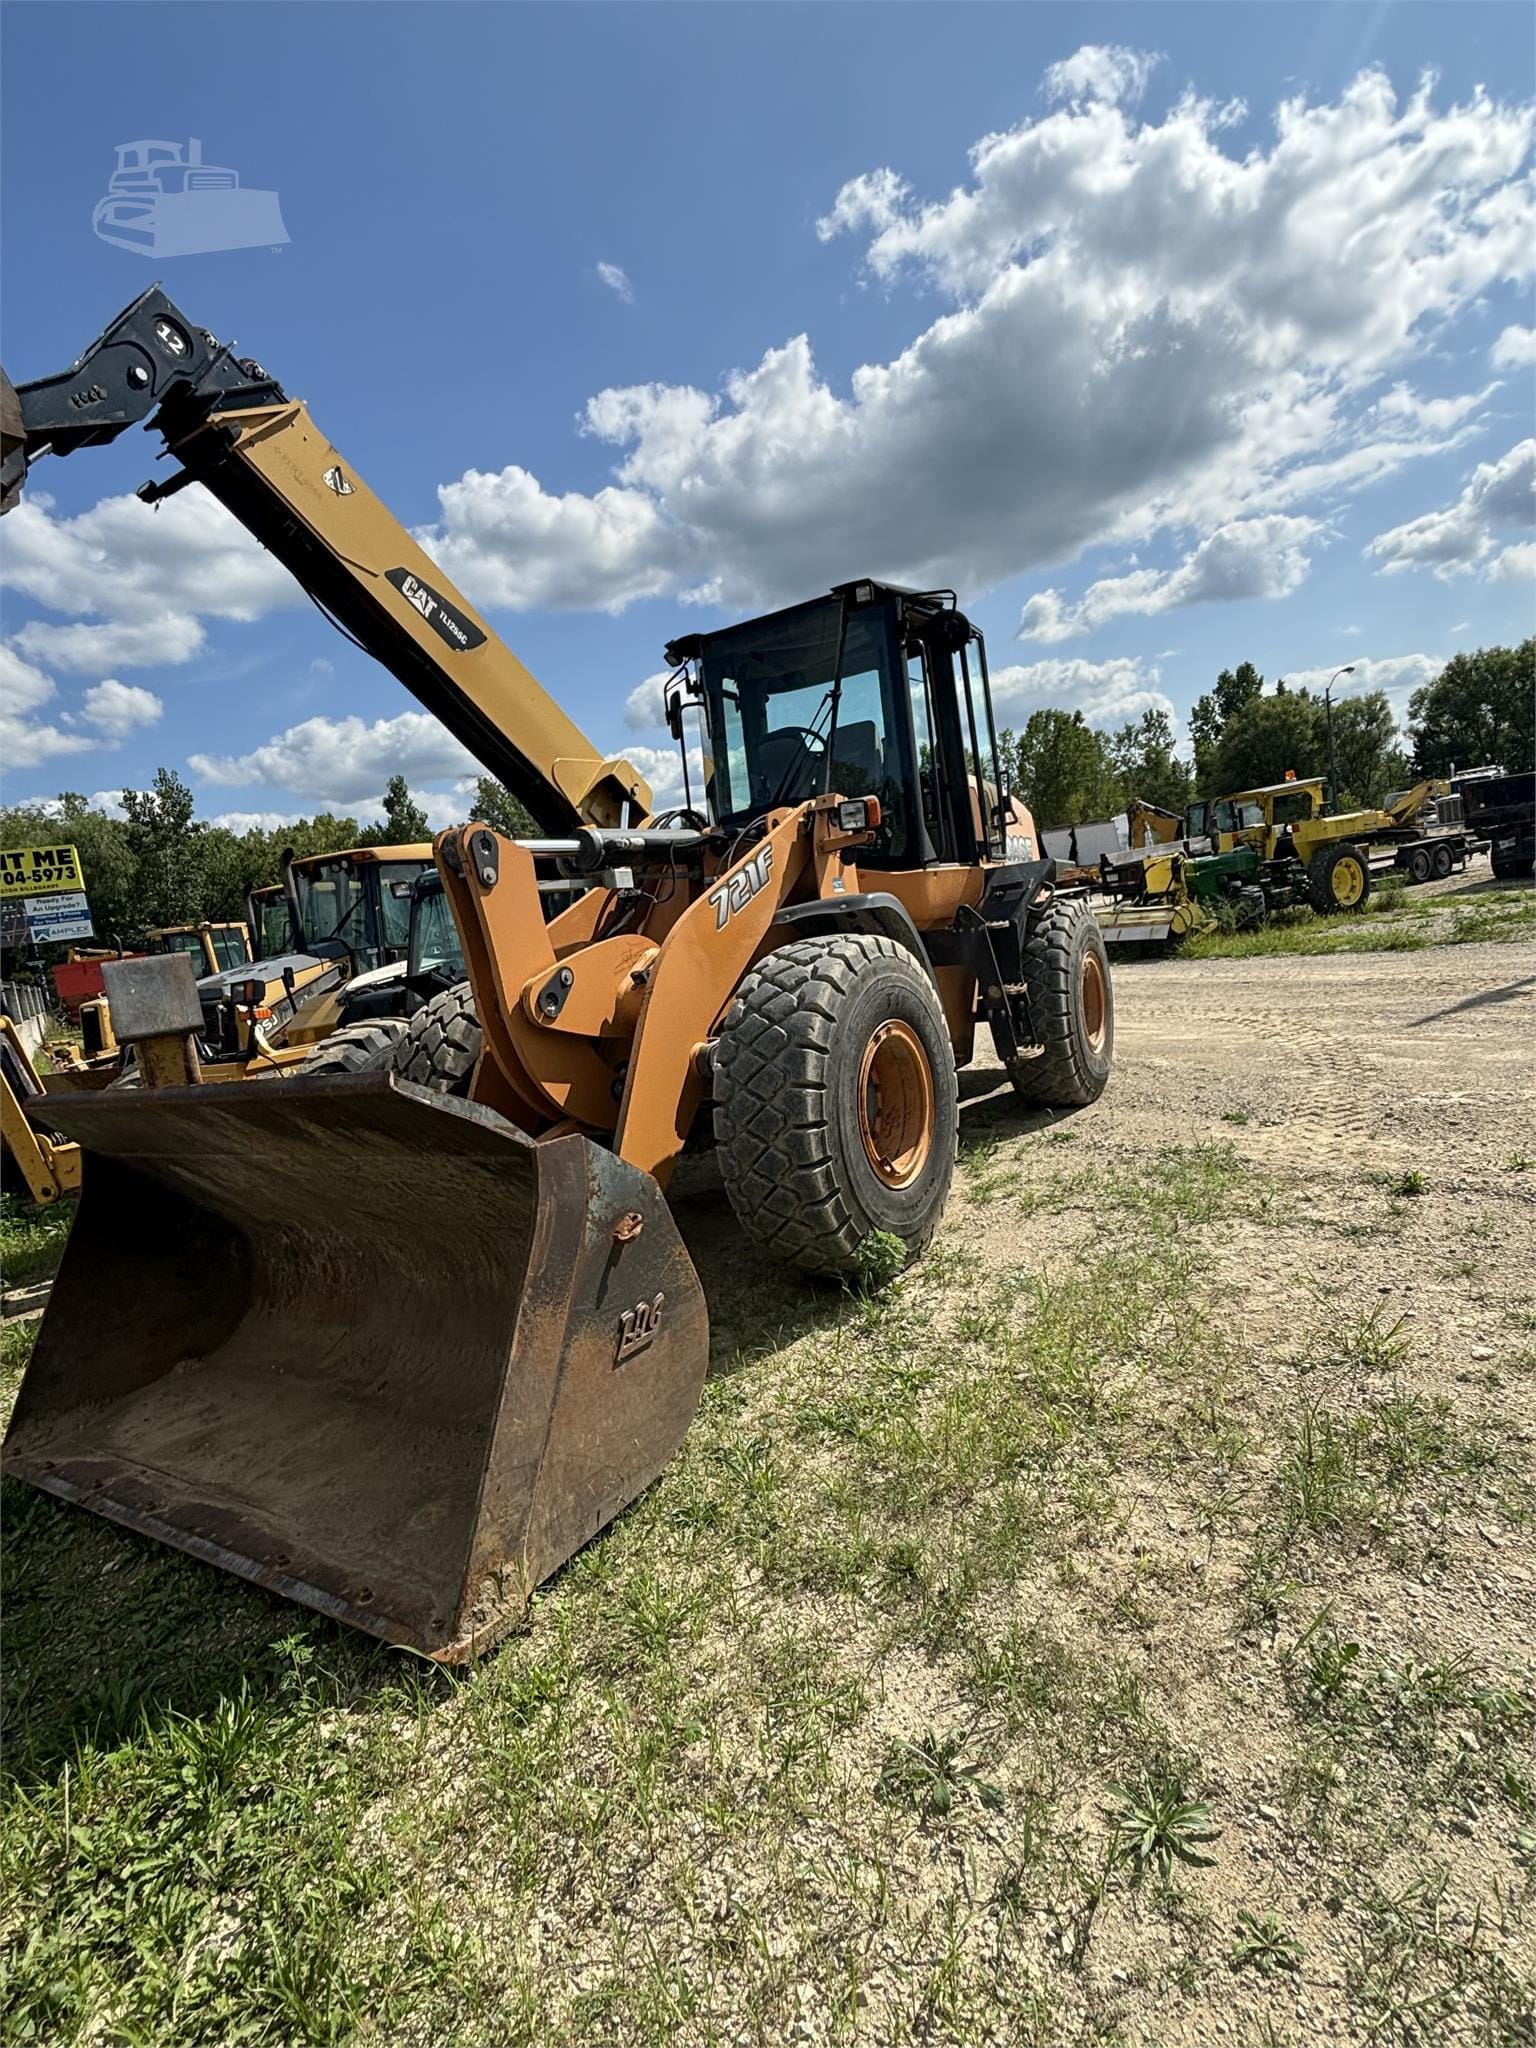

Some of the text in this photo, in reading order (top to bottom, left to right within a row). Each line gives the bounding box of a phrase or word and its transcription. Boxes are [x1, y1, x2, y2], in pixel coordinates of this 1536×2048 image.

[157, 324, 184, 355] 12
[402, 575, 438, 619] CAT
[32, 848, 74, 867] ME
[0, 866, 76, 886] 04-5973
[708, 840, 773, 930] 721F
[44, 902, 81, 912] Upgrade?
[51, 925, 89, 935] AMPLEX
